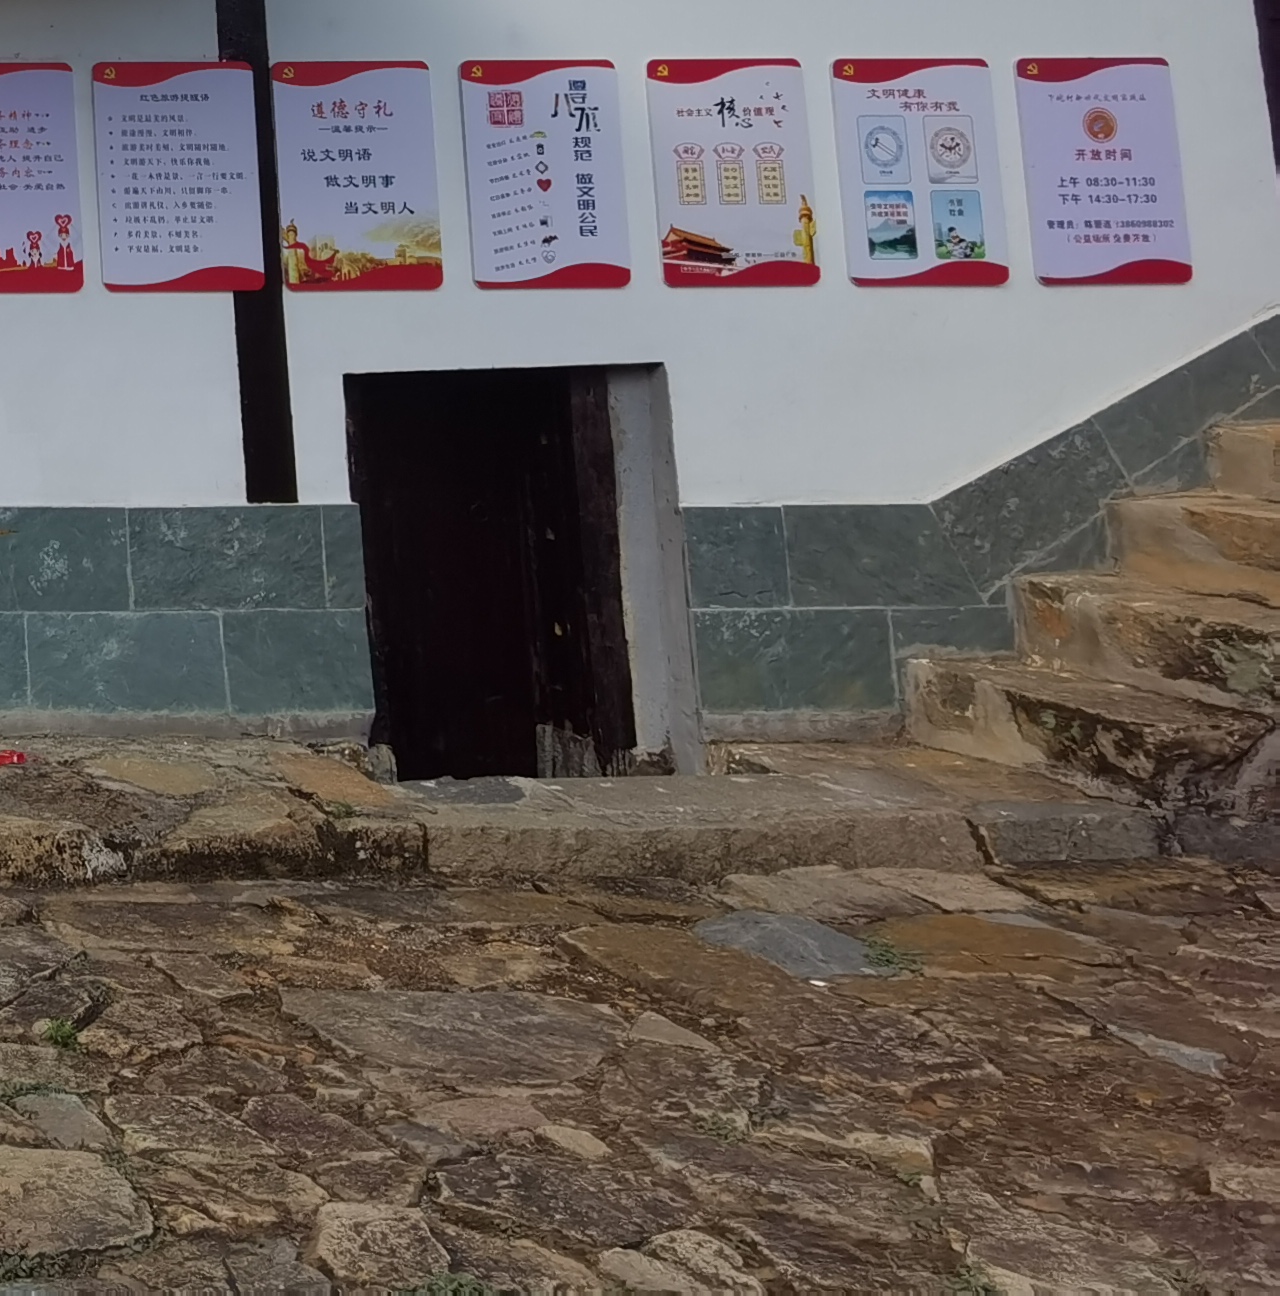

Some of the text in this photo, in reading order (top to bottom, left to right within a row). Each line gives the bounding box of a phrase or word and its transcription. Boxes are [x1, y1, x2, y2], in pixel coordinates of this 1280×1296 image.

[866, 88, 927, 99] 文明健康
[311, 98, 393, 119] 道德守礼
[899, 101, 960, 112] 有你有我
[300, 148, 373, 162] 说文明语
[1074, 149, 1133, 161] 开放时间
[323, 174, 396, 188] 做文明事
[1057, 176, 1080, 188] 上午
[575, 173, 599, 237] 做文明公民
[1058, 193, 1082, 205] 下午
[344, 201, 415, 215] 当文明人
